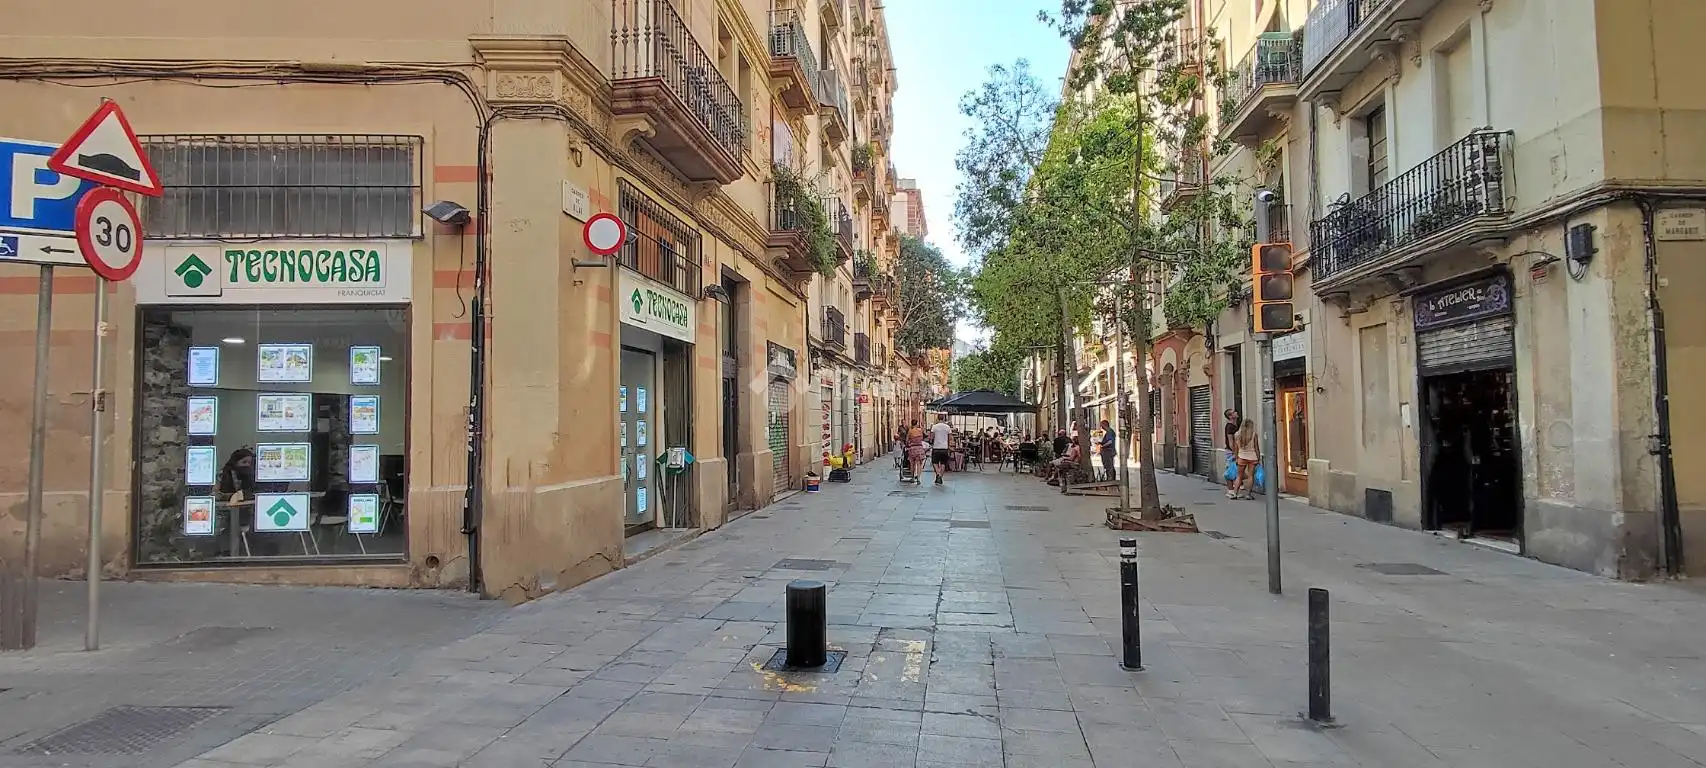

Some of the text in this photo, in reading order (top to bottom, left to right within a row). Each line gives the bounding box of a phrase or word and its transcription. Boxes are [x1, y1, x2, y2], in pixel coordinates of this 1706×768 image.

[11, 152, 82, 219] P
[96, 216, 132, 254] 30
[224, 249, 381, 283] TECNOCASA
[646, 288, 688, 329] TECNOCASA
